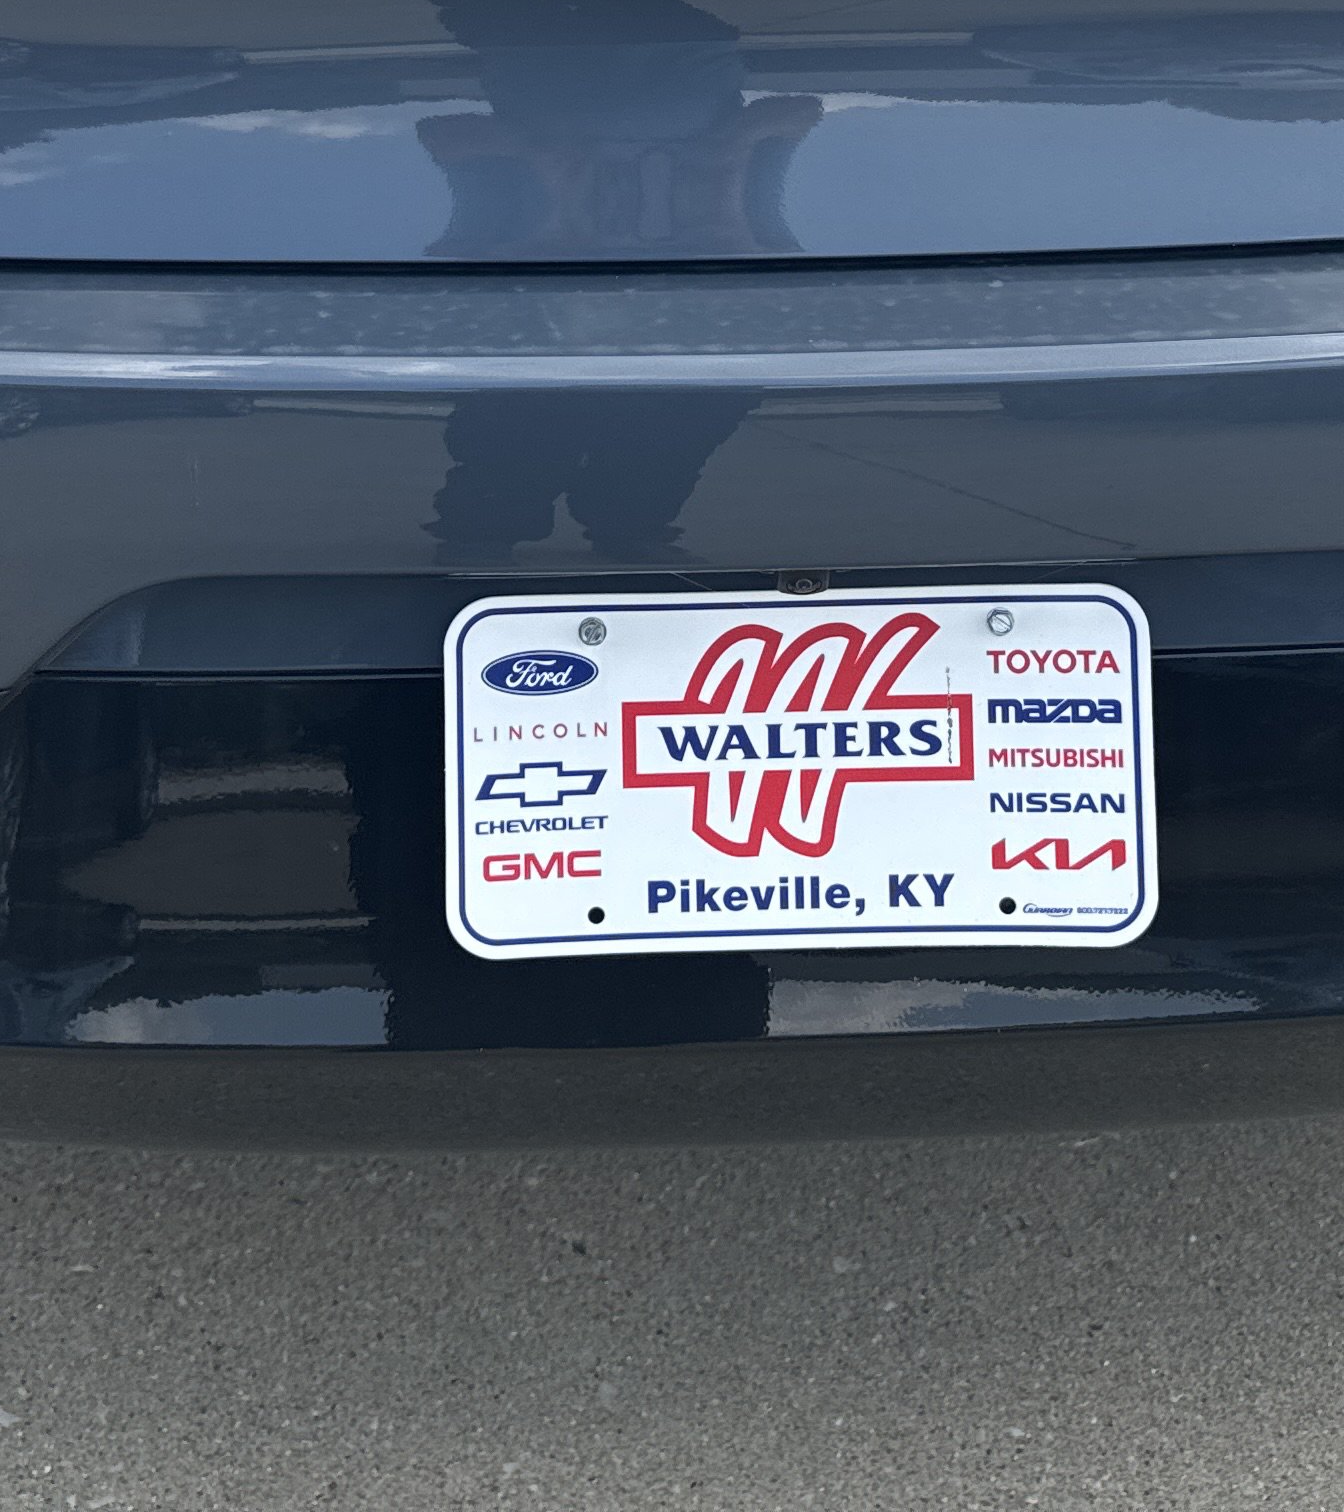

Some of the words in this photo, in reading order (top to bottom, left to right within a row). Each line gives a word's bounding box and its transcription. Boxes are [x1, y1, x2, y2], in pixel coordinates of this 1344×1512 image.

[506, 659, 574, 688] Ford
[986, 649, 1120, 674] TOYOTA
[474, 721, 608, 743] LINCOLN
[657, 719, 943, 762] WALTERS
[988, 748, 1124, 768] MITSUBISHI
[990, 792, 1126, 814] NISSAN
[475, 815, 609, 836] CHEVROLET
[483, 850, 602, 882] GMC
[991, 838, 1127, 872] KIA
[647, 875, 866, 916] Pikeville,
[888, 873, 955, 908] KY
